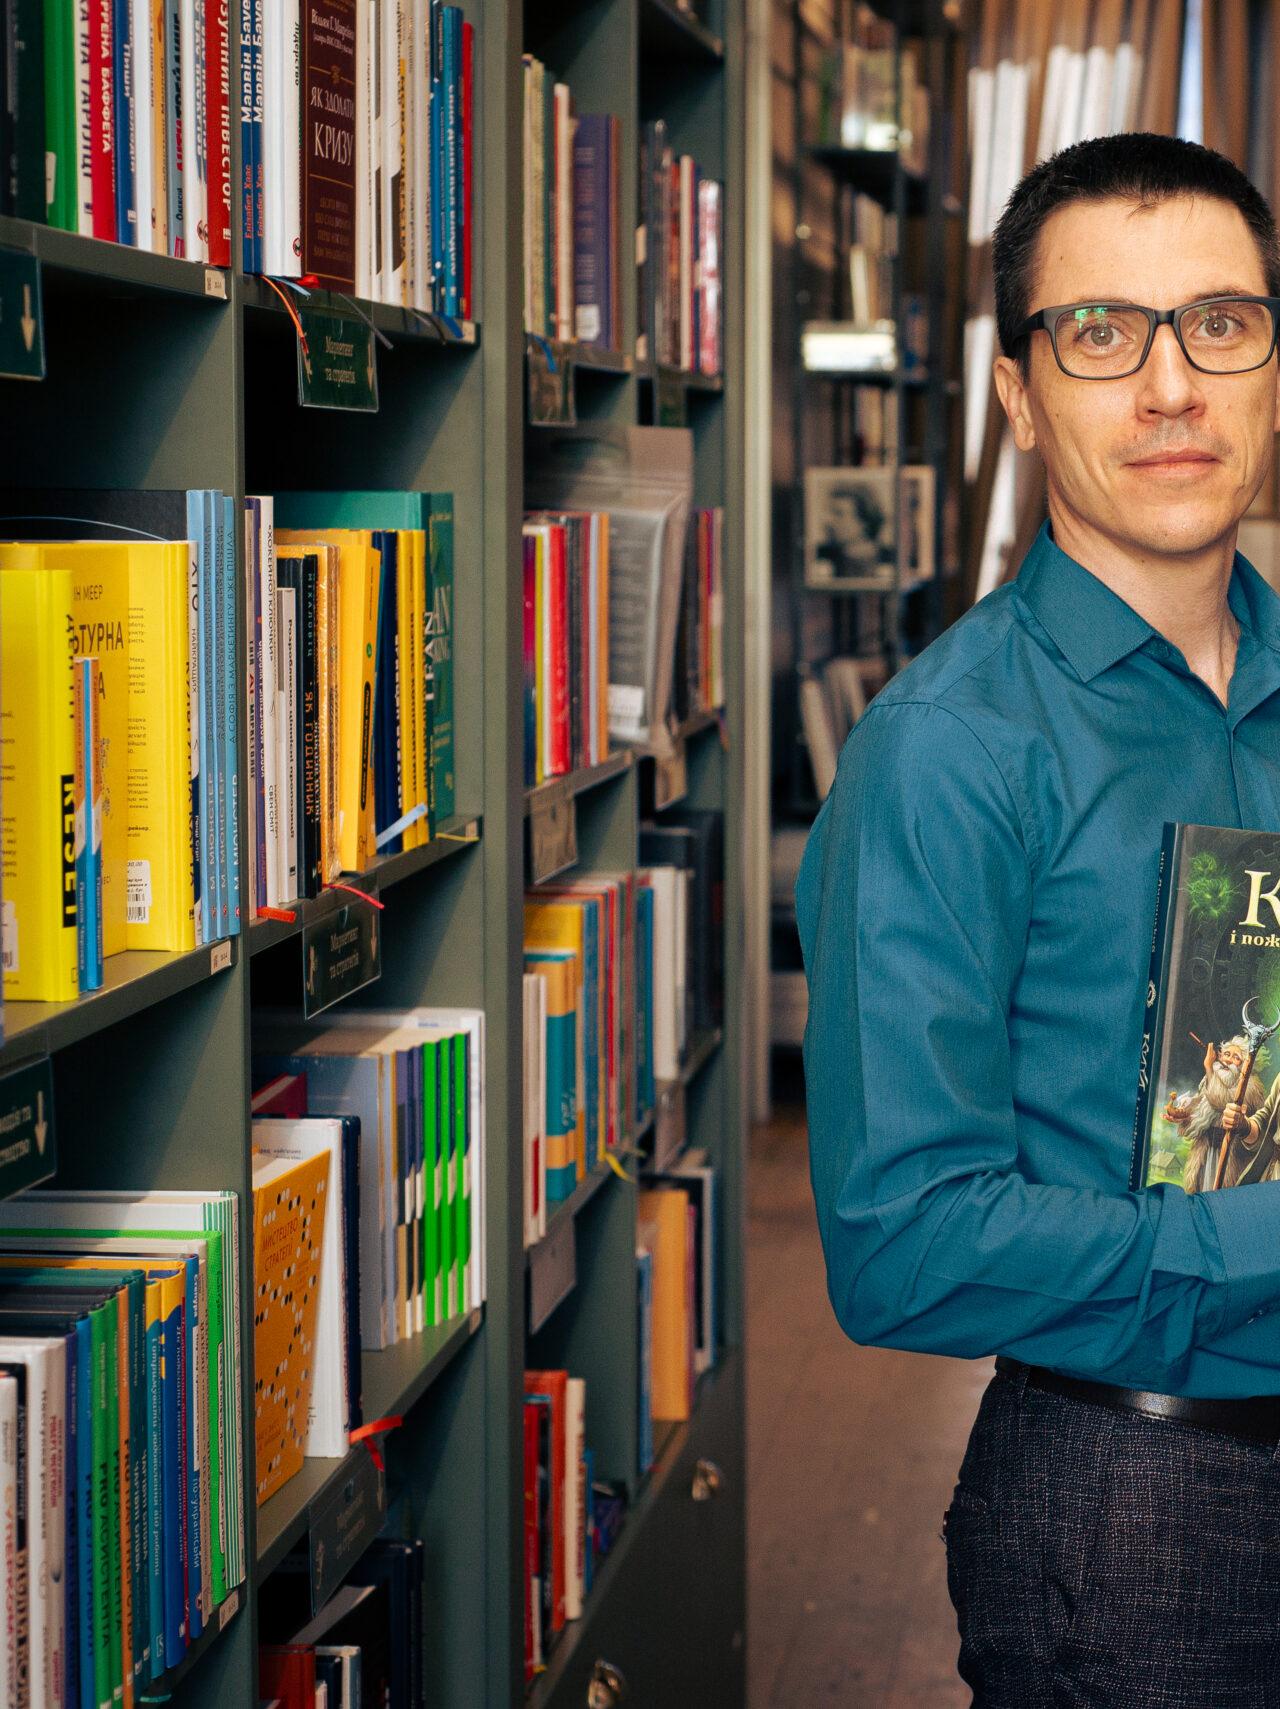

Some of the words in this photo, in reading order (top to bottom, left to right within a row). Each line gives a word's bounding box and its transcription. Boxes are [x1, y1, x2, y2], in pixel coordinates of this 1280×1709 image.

[101, 66, 111, 153] БАФФЕТА
[240, 51, 252, 123] Марвін
[252, 52, 264, 123] Марвін
[310, 85, 324, 109] ЯК
[221, 104, 231, 212] ІНВЕСТОР
[314, 122, 354, 167] КРИЗУ
[226, 531, 234, 572] ПІШЛА
[226, 575, 234, 600] ВЖЕ
[73, 621, 125, 655] ЬТУРНА
[226, 603, 236, 679] МАРКЕТИНГУ
[228, 693, 237, 732] СОФІЯ
[305, 691, 314, 713] ЯК
[305, 719, 314, 815] ГОДИННИК
[1230, 930, 1237, 945] і
[101, 1460, 109, 1507] PRO
[153, 1530, 161, 1576] роботи
[100, 1513, 111, 1648] АСИСТЕНТА
